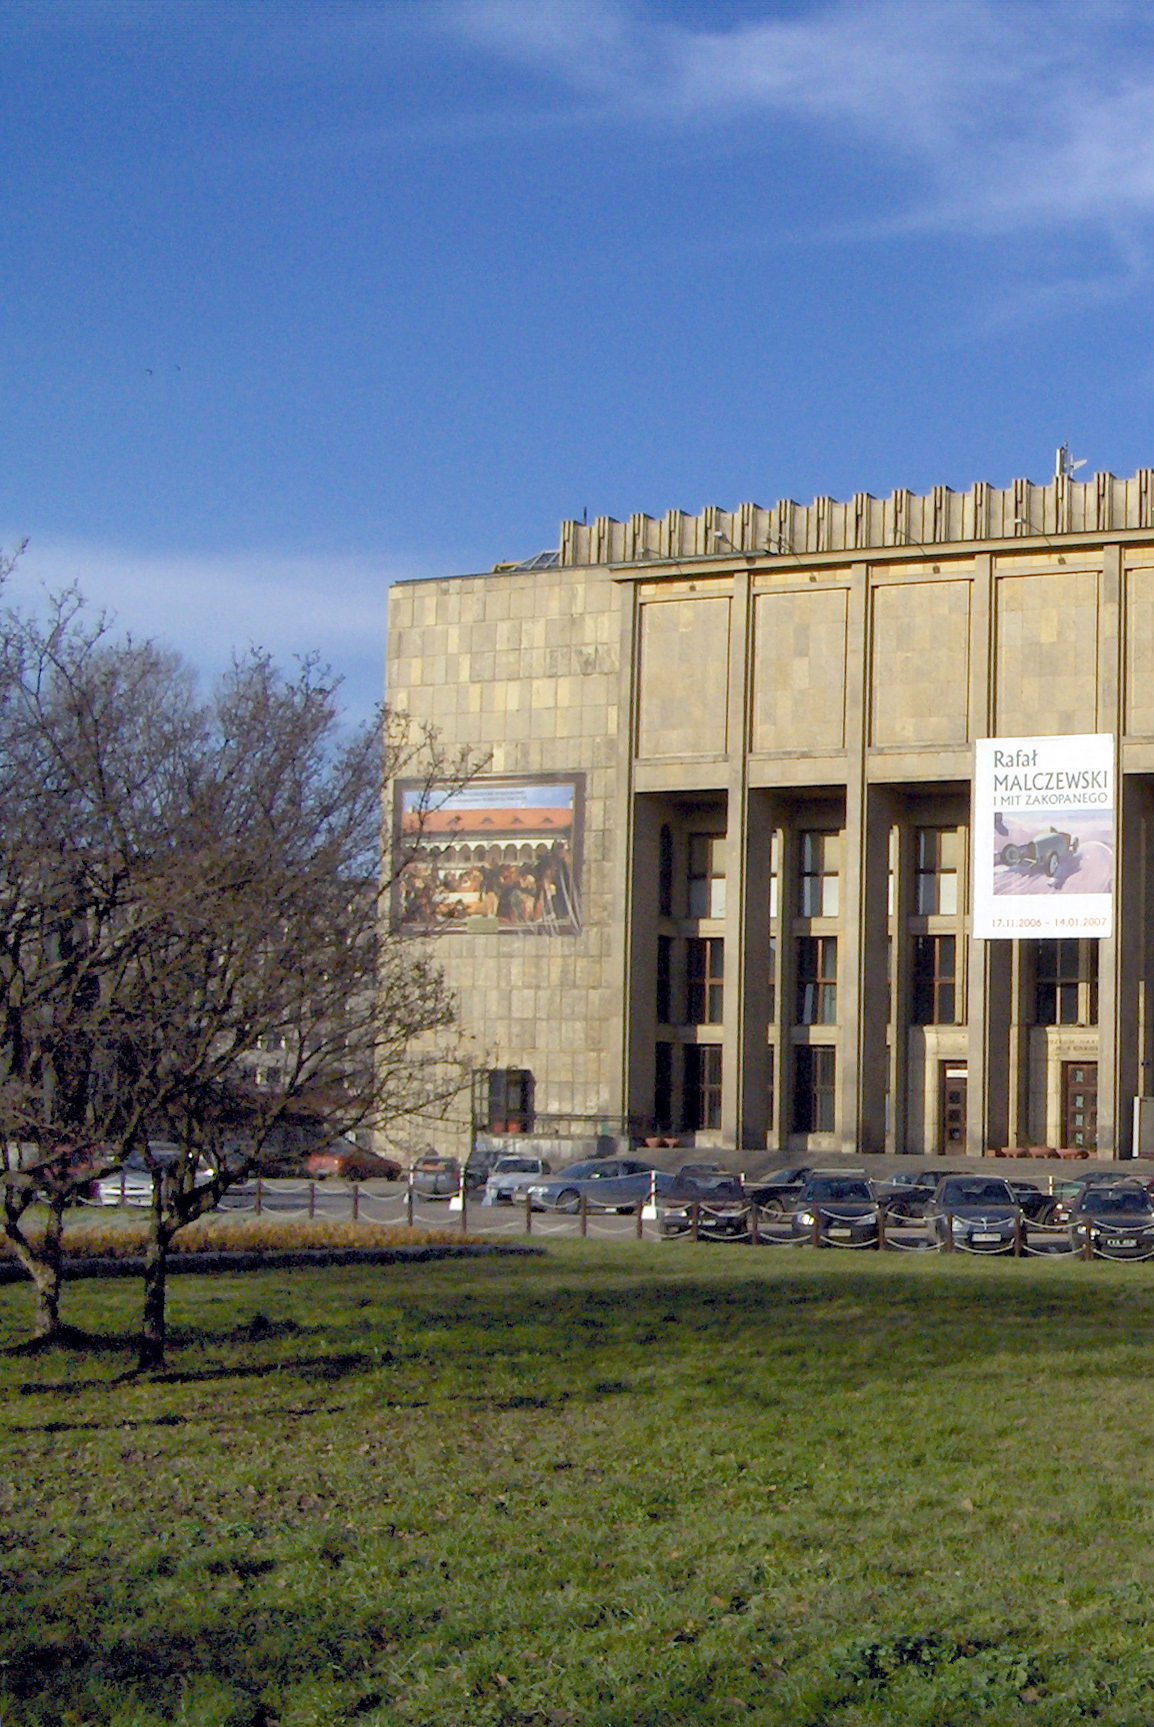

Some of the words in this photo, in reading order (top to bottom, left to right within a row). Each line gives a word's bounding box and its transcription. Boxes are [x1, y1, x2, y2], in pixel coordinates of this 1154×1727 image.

[994, 749, 1038, 768] Rafał
[994, 770, 1108, 792] MALCZEWSKI
[993, 796, 997, 806] I
[1001, 795, 1021, 806] MIT
[1025, 792, 1108, 806] ZAKOPANEGO
[991, 918, 1041, 928] 17.11.2006
[1055, 917, 1107, 928] 14.01.2007
